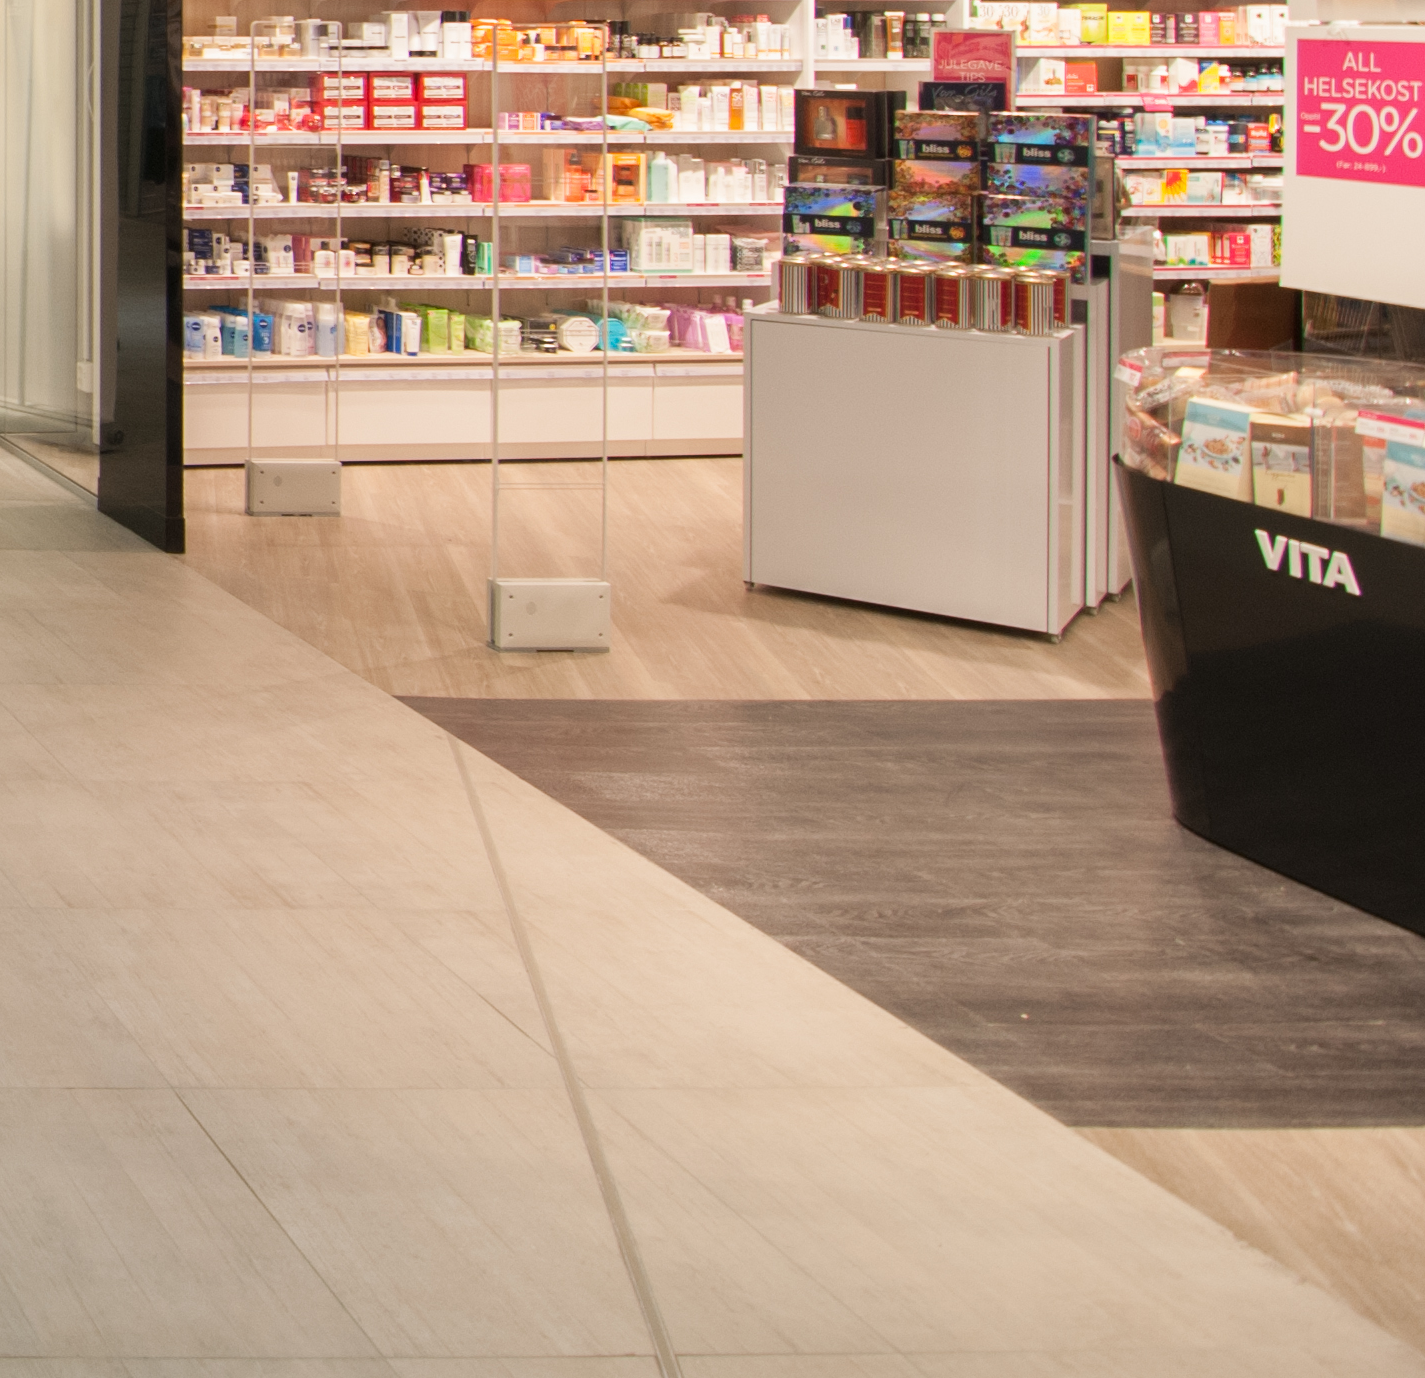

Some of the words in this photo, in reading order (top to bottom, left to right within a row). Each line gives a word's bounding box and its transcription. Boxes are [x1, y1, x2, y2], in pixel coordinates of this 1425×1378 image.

[938, 59, 1002, 71] JULEGAVE
[1342, 51, 1381, 72] ALL
[959, 72, 986, 82] TIPS
[1303, 76, 1423, 102] HELSEKOST
[1303, 102, 1424, 159] -30%
[921, 142, 950, 155] bliss
[1022, 146, 1051, 158] bliss
[814, 217, 841, 229] bliss
[915, 224, 942, 236] bliss
[1018, 230, 1048, 243] bliss
[1254, 529, 1362, 597] VITA
